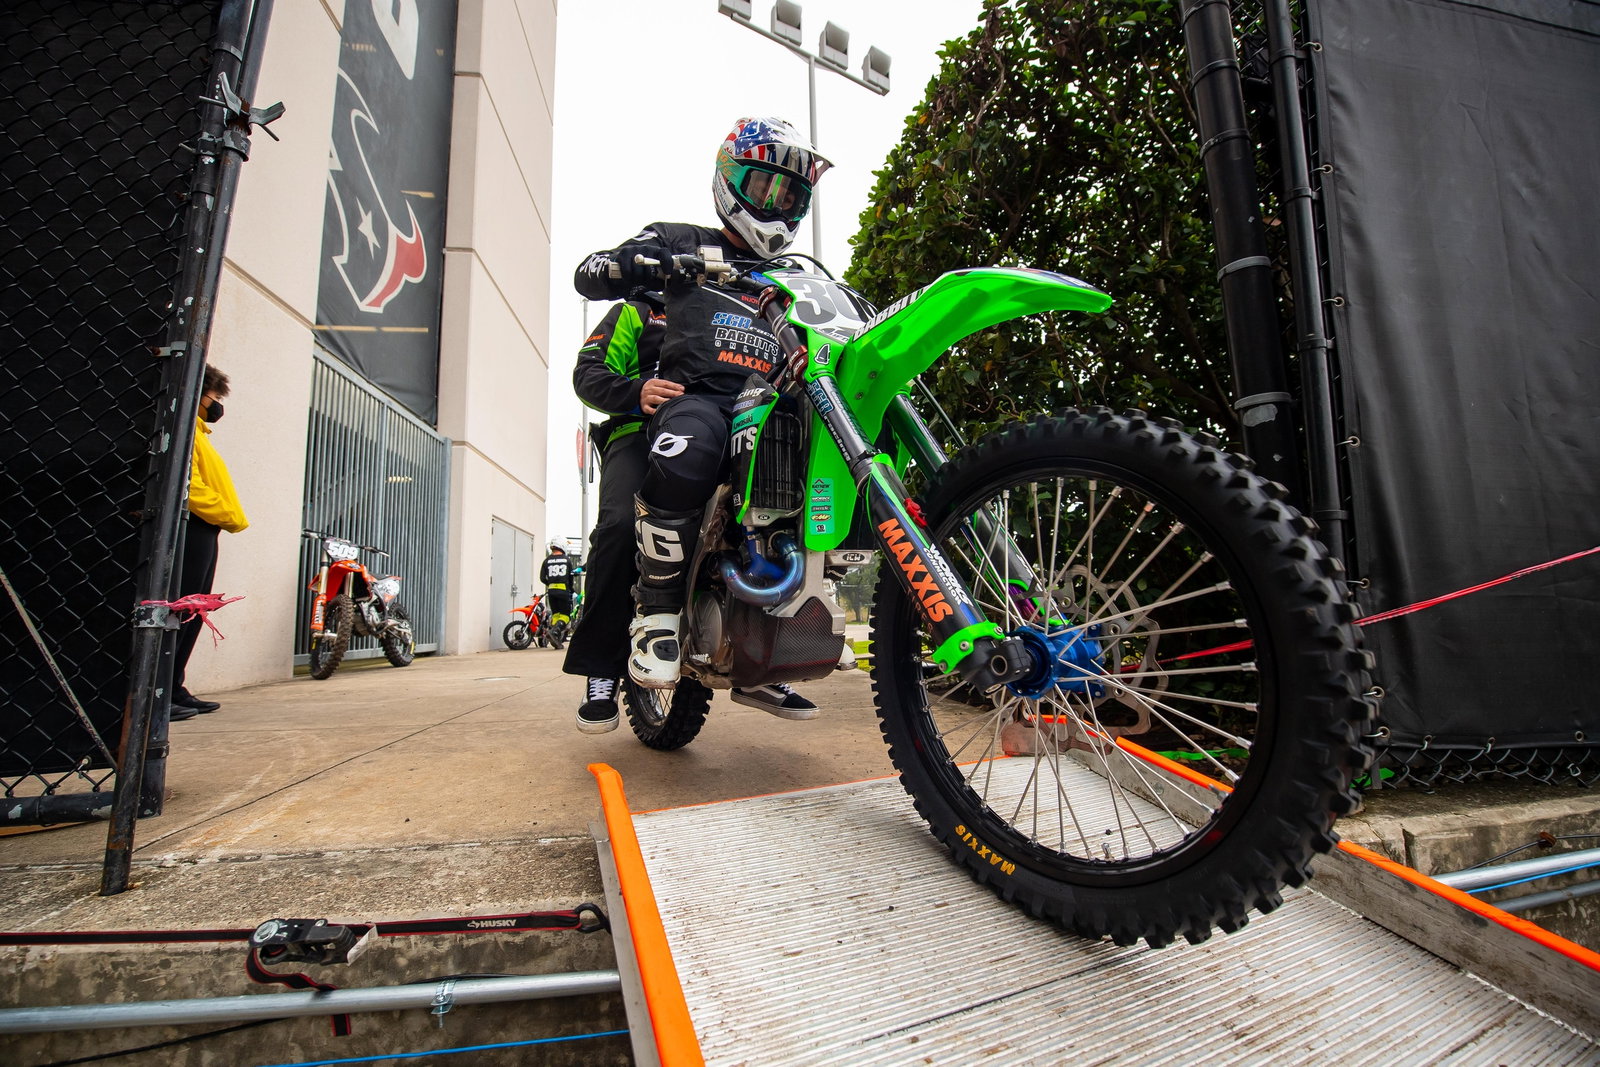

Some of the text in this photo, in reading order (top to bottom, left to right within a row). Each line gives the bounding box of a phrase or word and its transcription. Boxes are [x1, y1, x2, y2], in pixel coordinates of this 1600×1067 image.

[715, 327, 778, 356] BABBITT'S
[717, 350, 772, 373] MAXXIS
[328, 542, 359, 560] 509
[547, 564, 568, 577] 193
[878, 518, 954, 623] MAXXIS
[923, 547, 962, 606] CONNECTION
[929, 543, 974, 607] WORKS
[955, 824, 1016, 876] MAXXIS
[480, 918, 518, 928] HUSKY
